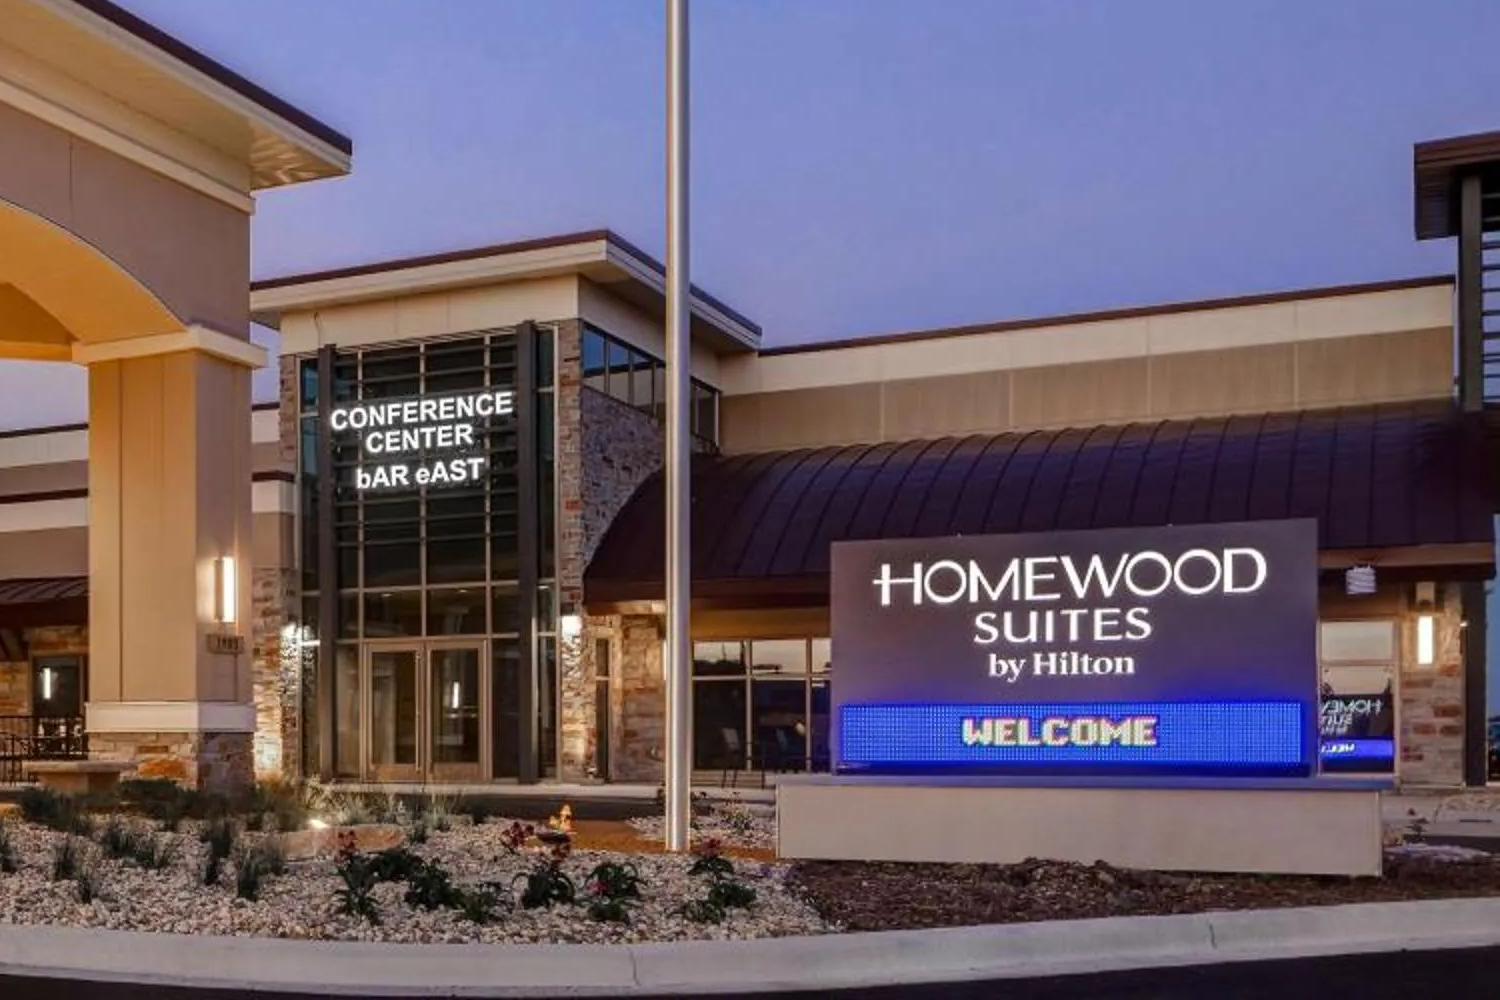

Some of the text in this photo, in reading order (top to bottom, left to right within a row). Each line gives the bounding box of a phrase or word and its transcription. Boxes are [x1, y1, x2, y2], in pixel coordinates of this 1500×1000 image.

[330, 391, 514, 431] CONFERENCE
[365, 423, 474, 453] CENTER
[356, 457, 485, 489] bAR eAST
[873, 547, 1268, 605] HOMEWOOD
[973, 606, 1153, 644] SUITES
[988, 651, 1136, 682] by Hilton
[961, 716, 1158, 747] WELCOME
